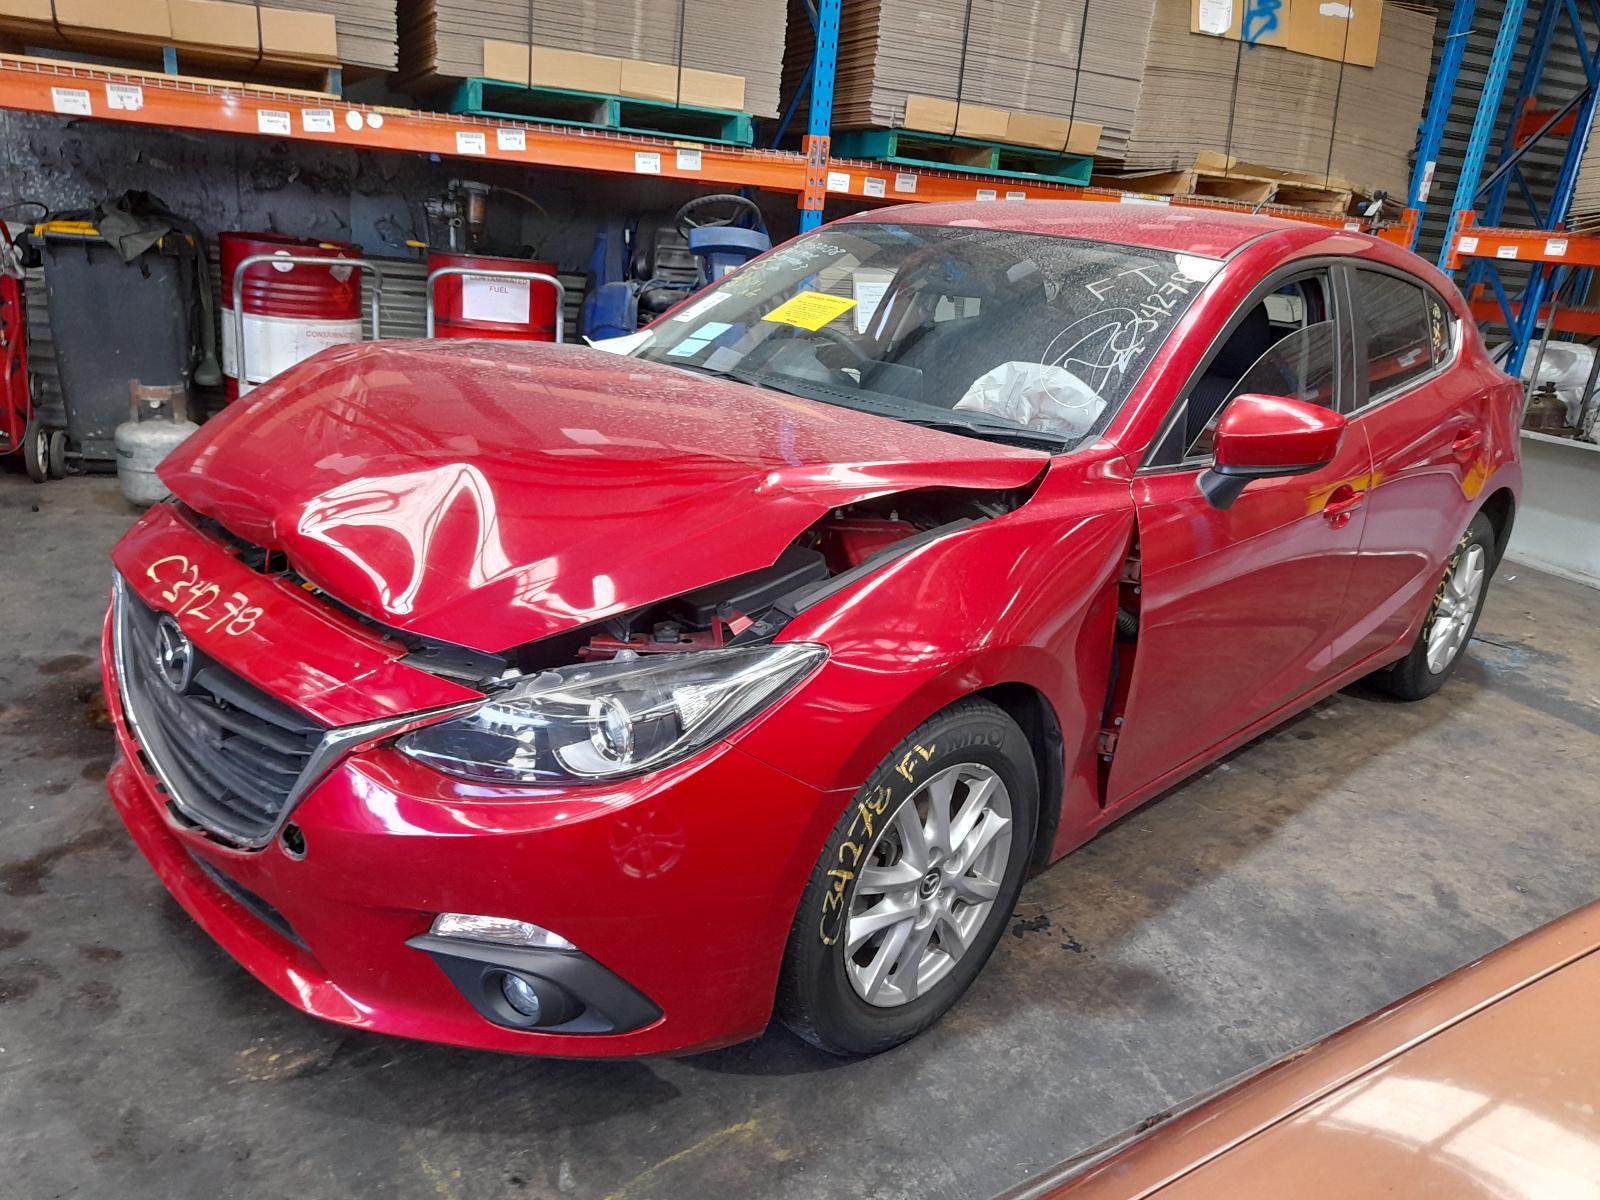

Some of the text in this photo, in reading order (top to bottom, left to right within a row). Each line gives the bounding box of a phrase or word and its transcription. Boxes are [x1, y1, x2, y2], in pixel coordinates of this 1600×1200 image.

[489, 285, 509, 294] FUEL
[147, 555, 263, 636] C34278
[896, 744, 937, 784] FL
